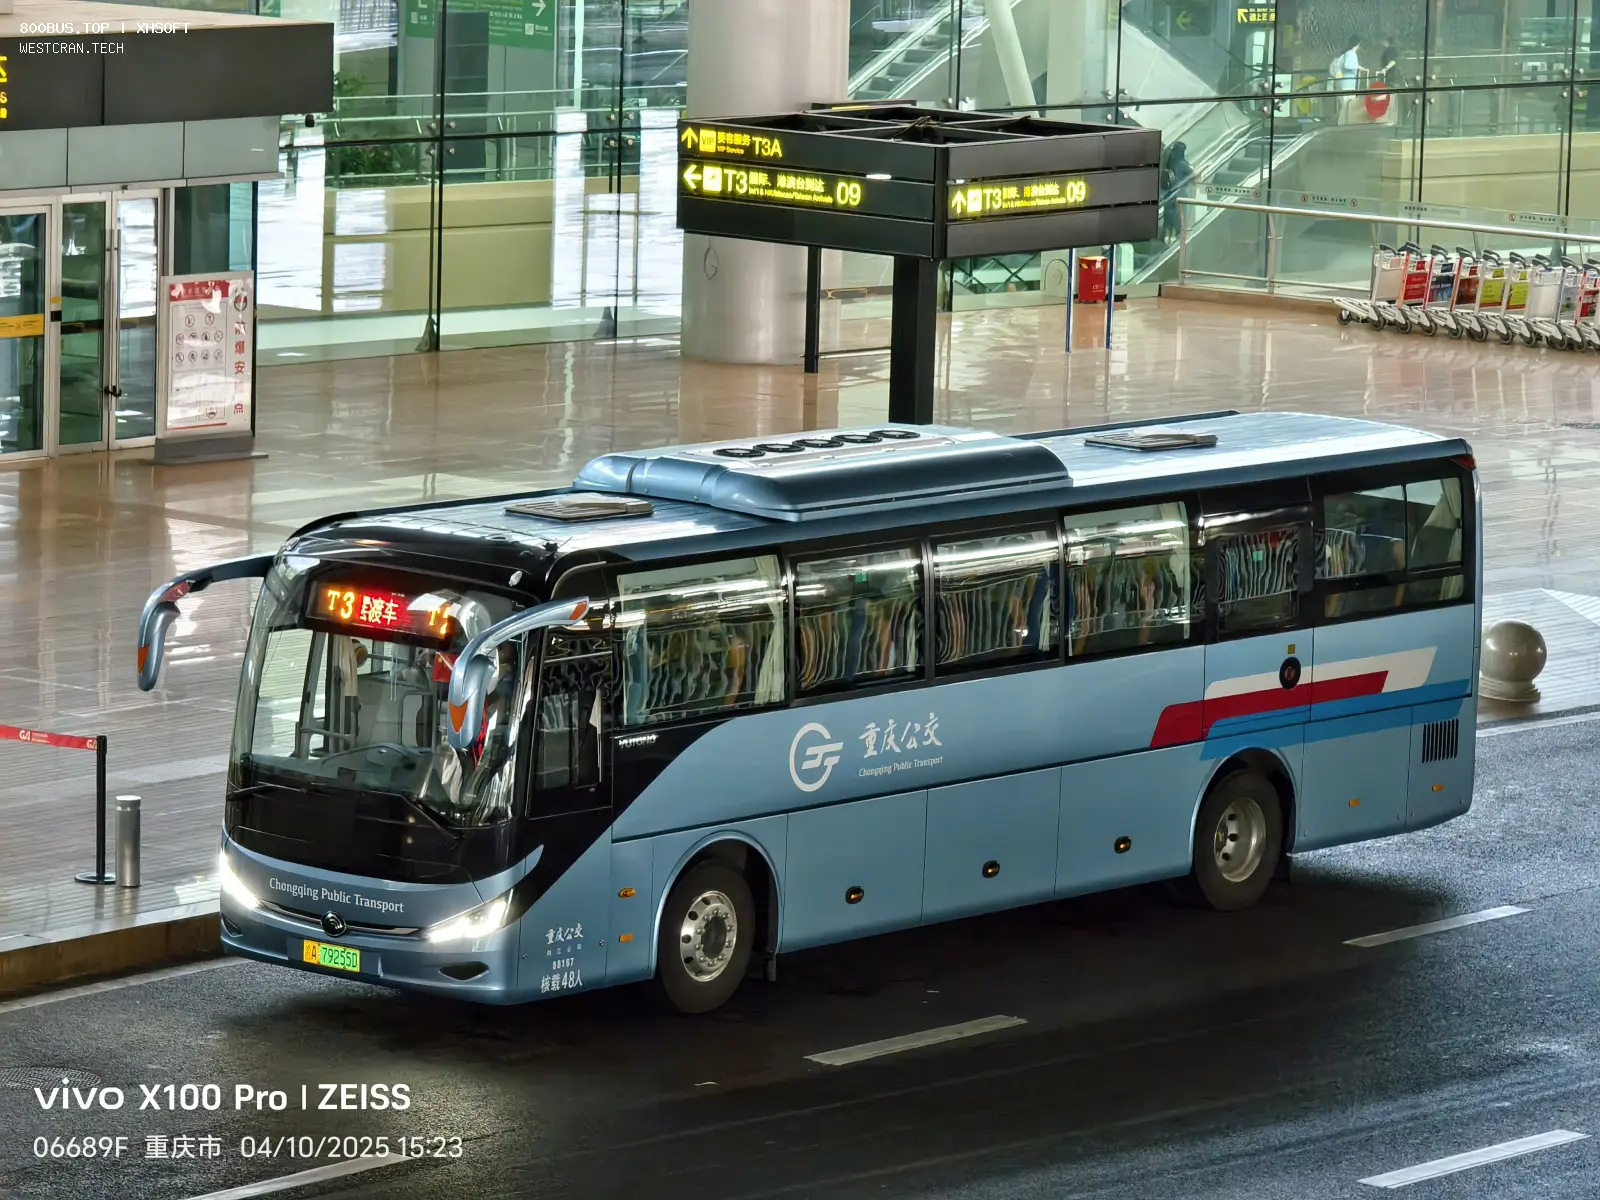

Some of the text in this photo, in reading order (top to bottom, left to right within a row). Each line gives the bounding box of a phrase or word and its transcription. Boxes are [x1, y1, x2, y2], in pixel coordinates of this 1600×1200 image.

[752, 136, 783, 157] T3A
[723, 168, 748, 195] T3
[836, 180, 862, 207] 09
[983, 187, 1003, 210] T3
[1066, 180, 1087, 203] 09
[327, 589, 356, 620] T3
[859, 711, 943, 759] 重庆公交
[858, 756, 944, 777] Chongqing Public Transport
[269, 877, 405, 913] Chongqing Public Transport
[545, 922, 584, 945] 重庆公交
